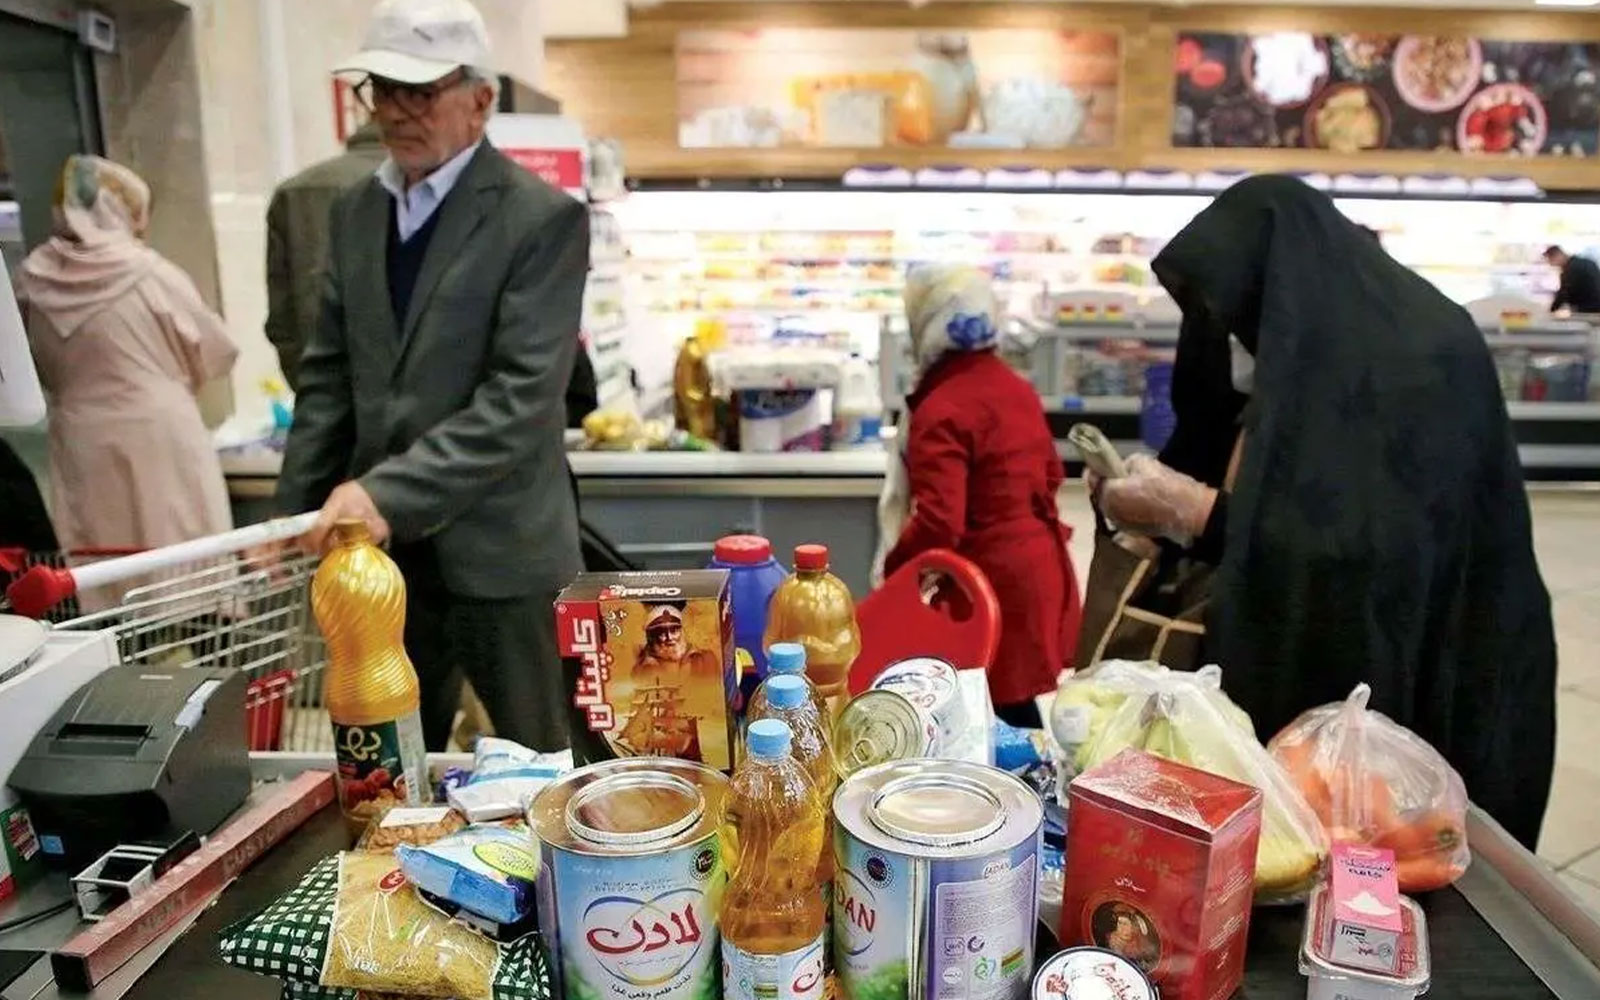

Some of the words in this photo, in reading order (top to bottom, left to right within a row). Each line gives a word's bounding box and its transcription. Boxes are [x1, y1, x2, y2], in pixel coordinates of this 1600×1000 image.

[609, 586, 681, 598] Captain
[571, 617, 615, 730] کاپیتان
[586, 903, 701, 955] لادن
[836, 882, 876, 932] DAN
